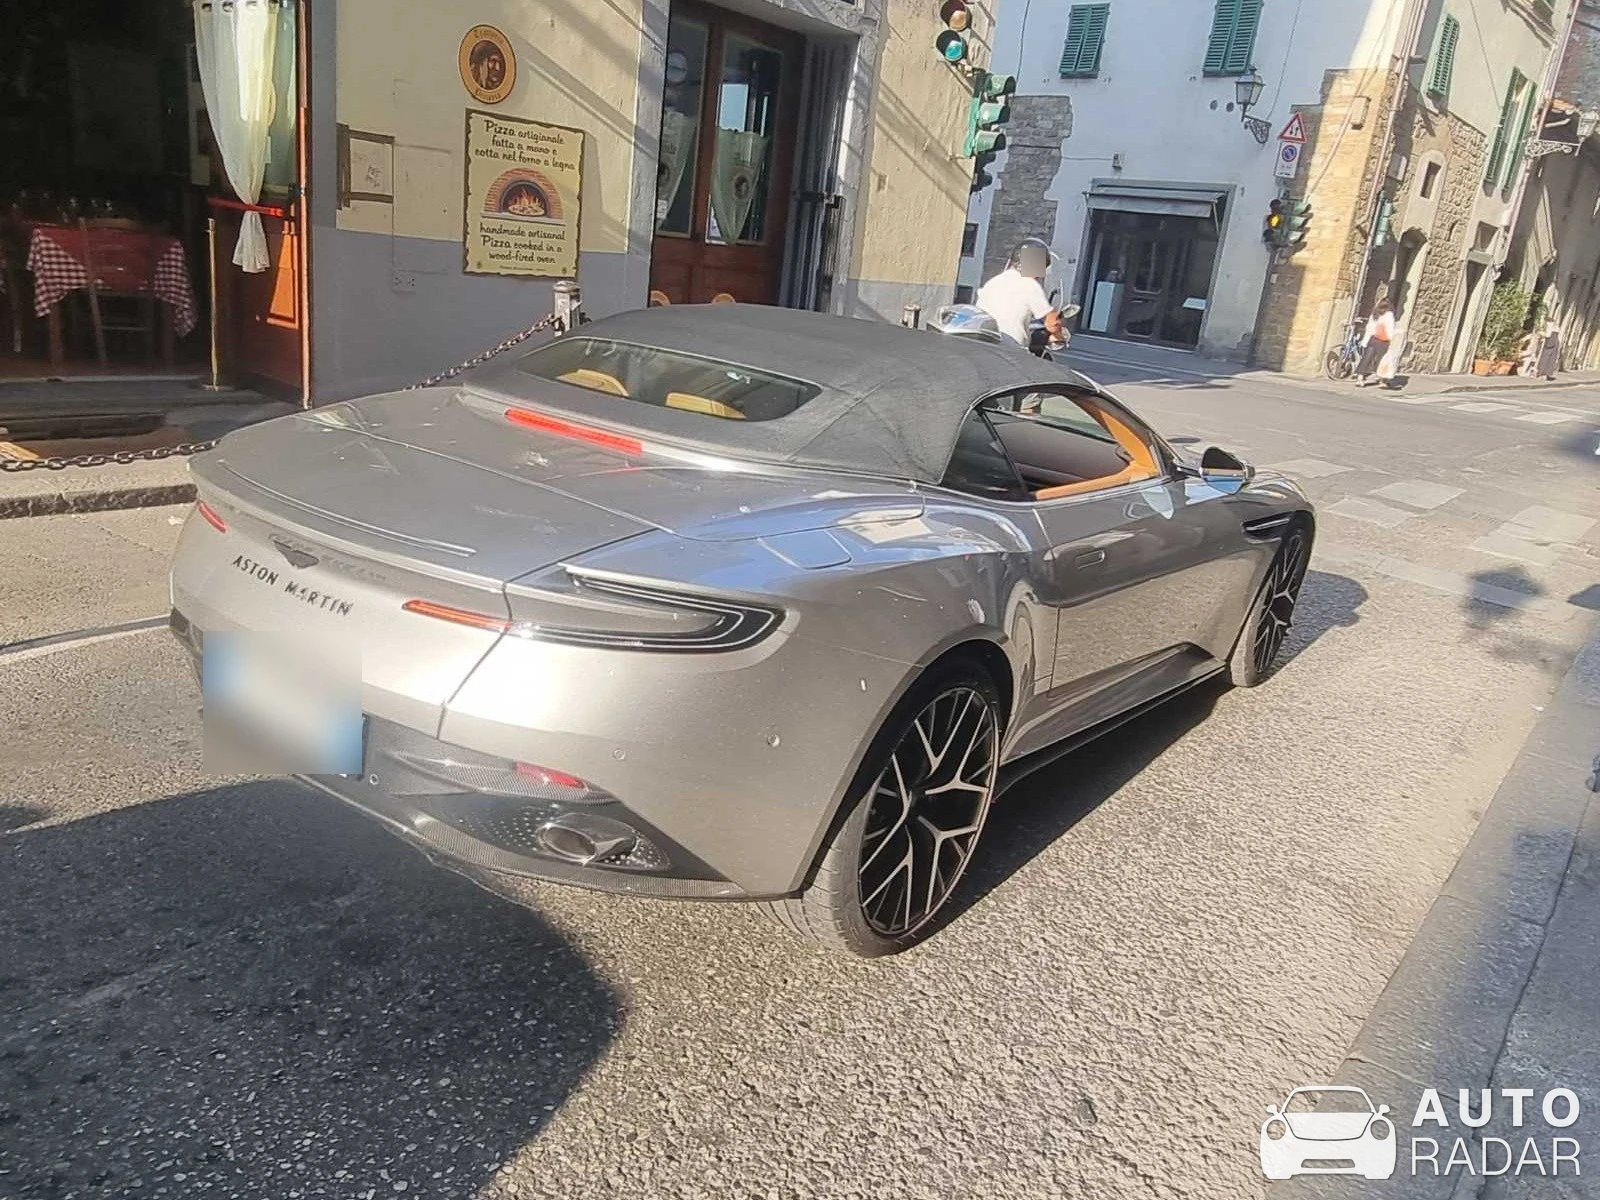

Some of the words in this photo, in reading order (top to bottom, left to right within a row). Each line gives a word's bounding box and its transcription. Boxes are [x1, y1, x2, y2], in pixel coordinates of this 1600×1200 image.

[484, 119, 516, 136] Pizza
[518, 130, 564, 144] artigianale
[491, 134, 515, 148] fatta
[526, 145, 550, 154] mano
[474, 148, 499, 159] cotta
[502, 151, 517, 162] nel
[518, 151, 541, 165] forno
[552, 157, 575, 172] legna
[480, 221, 526, 237] handmade
[528, 230, 566, 240] artisanal
[480, 234, 512, 248] Pizza
[513, 239, 544, 251] cooked
[546, 243, 554, 252] in
[488, 250, 535, 262] wood-fired
[536, 256, 556, 264] oven
[232, 554, 279, 586] ASTON
[285, 580, 354, 616] MARTIN
